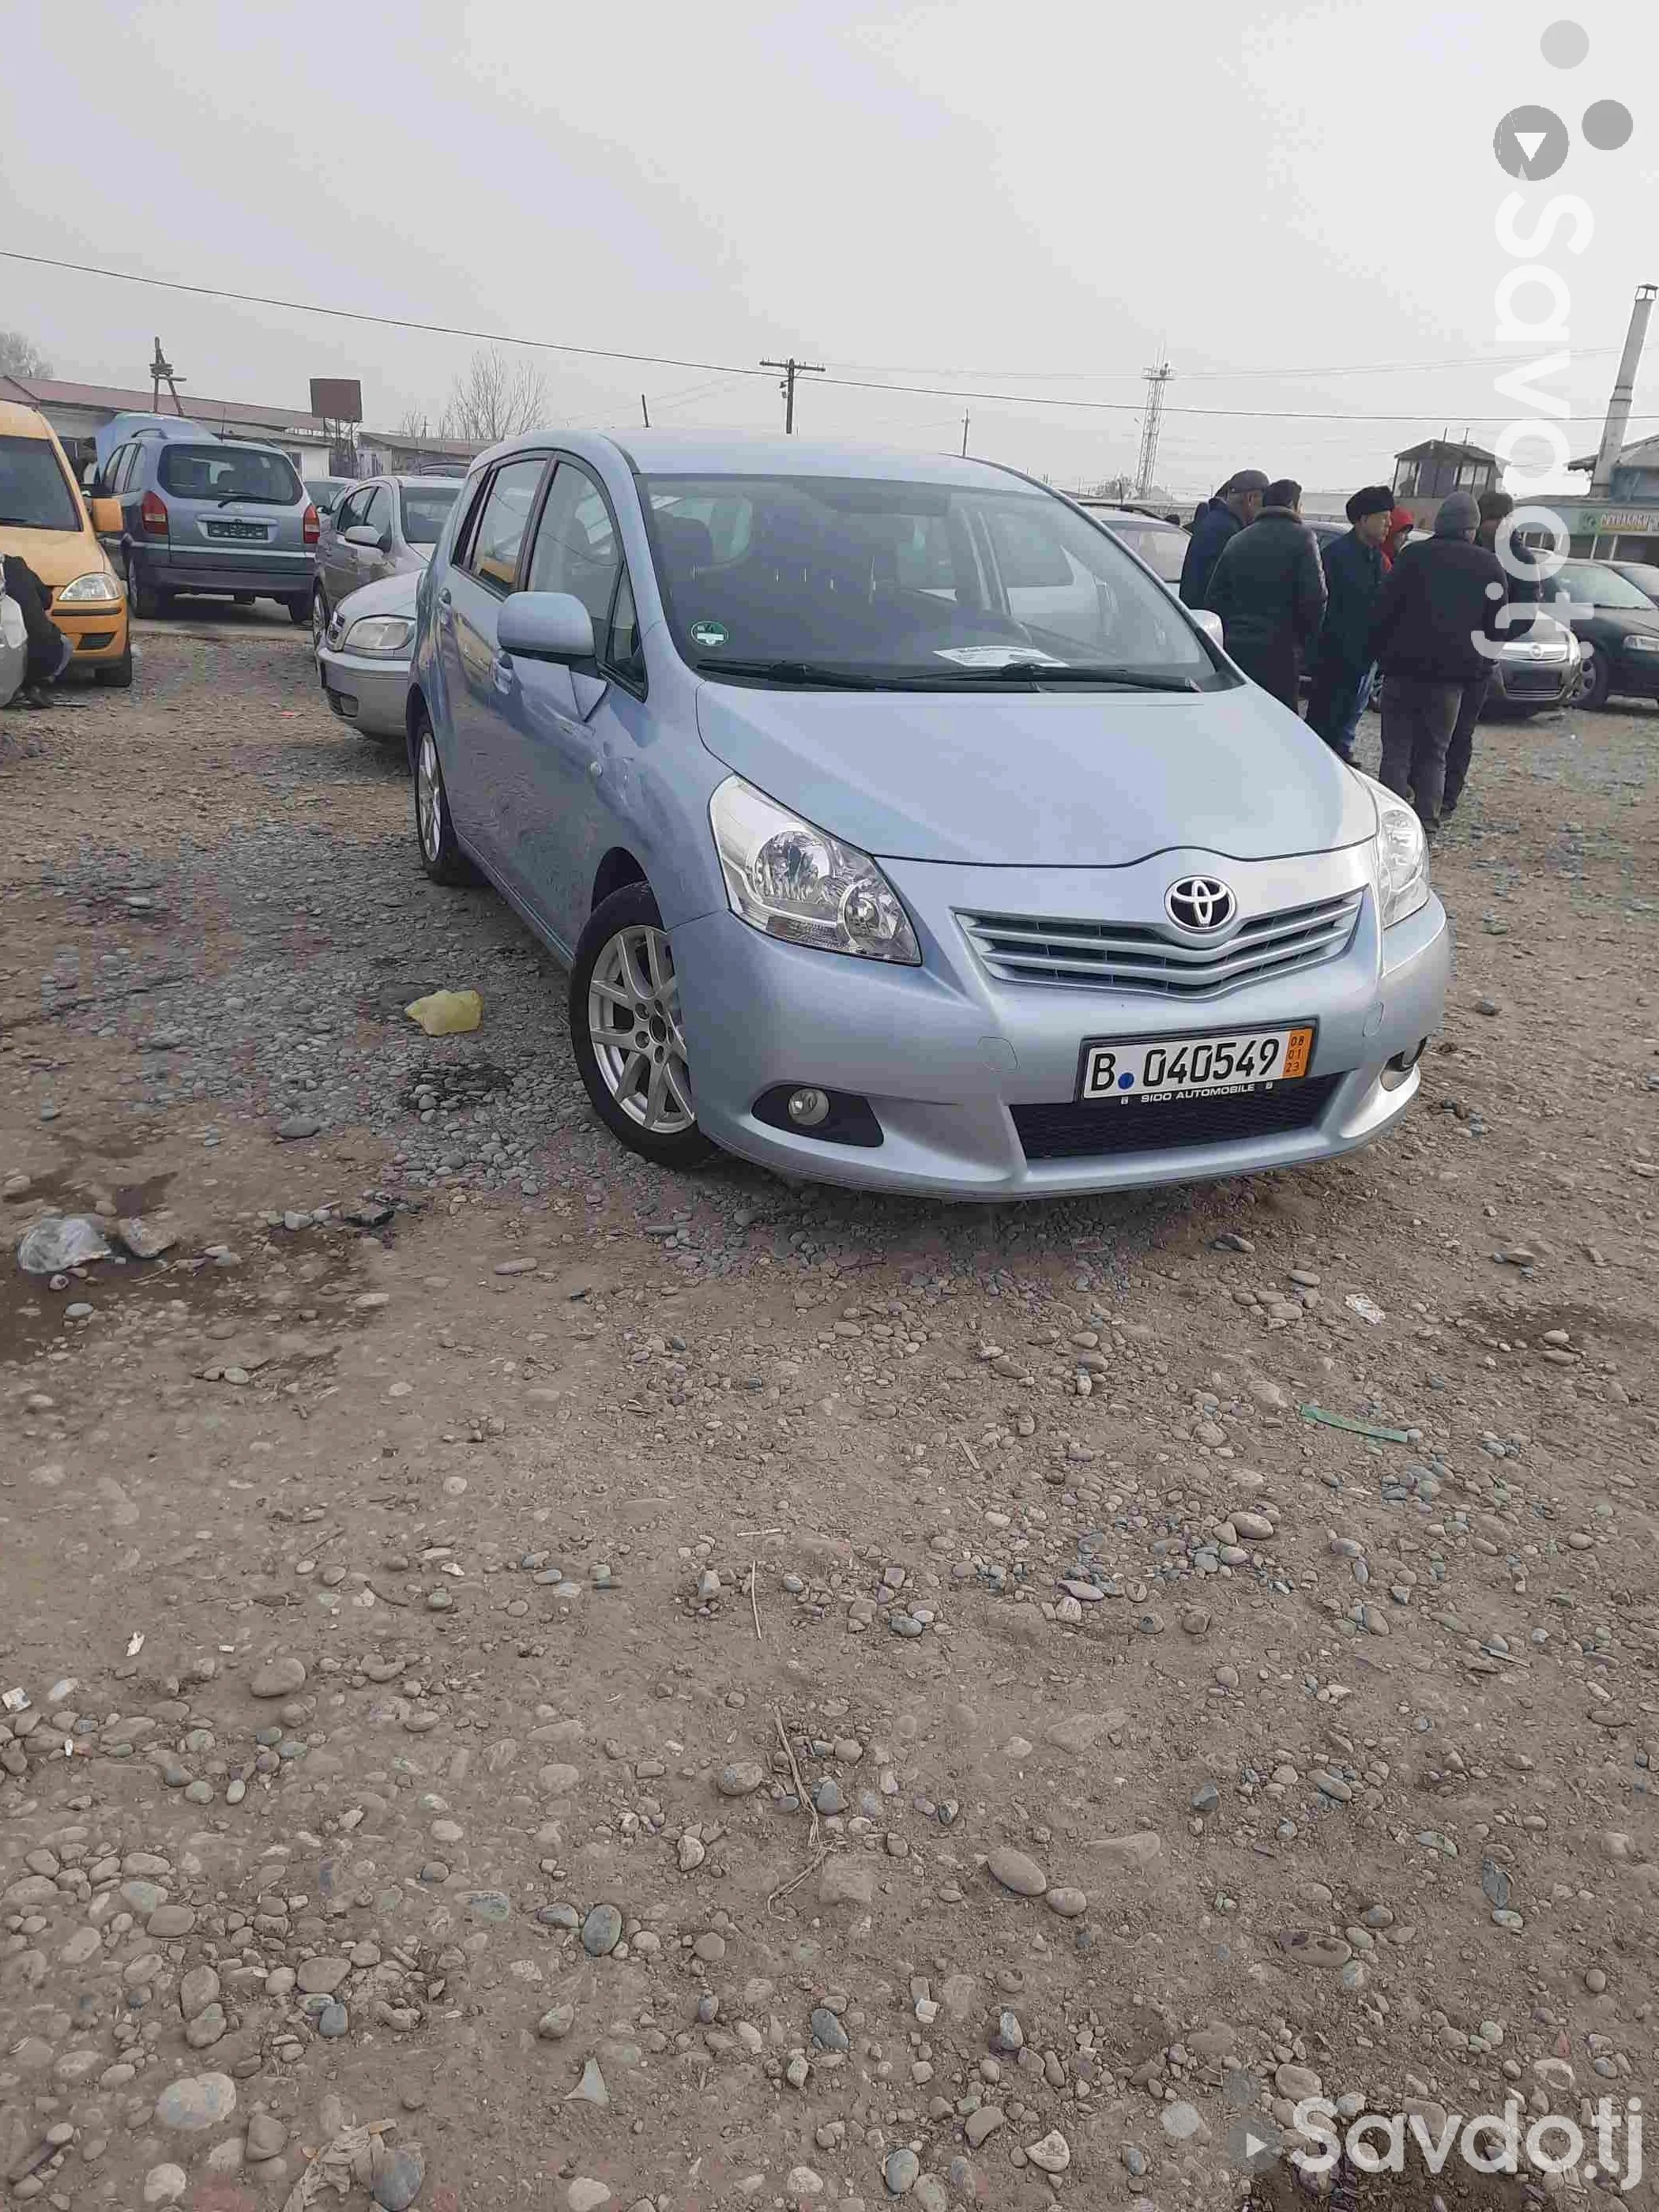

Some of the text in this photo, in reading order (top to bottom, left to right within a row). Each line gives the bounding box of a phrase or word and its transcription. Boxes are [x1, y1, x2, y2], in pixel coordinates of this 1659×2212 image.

[1091, 1038, 1280, 1091] B 040549
[1176, 1083, 1255, 1100] AUTOMOBILE
